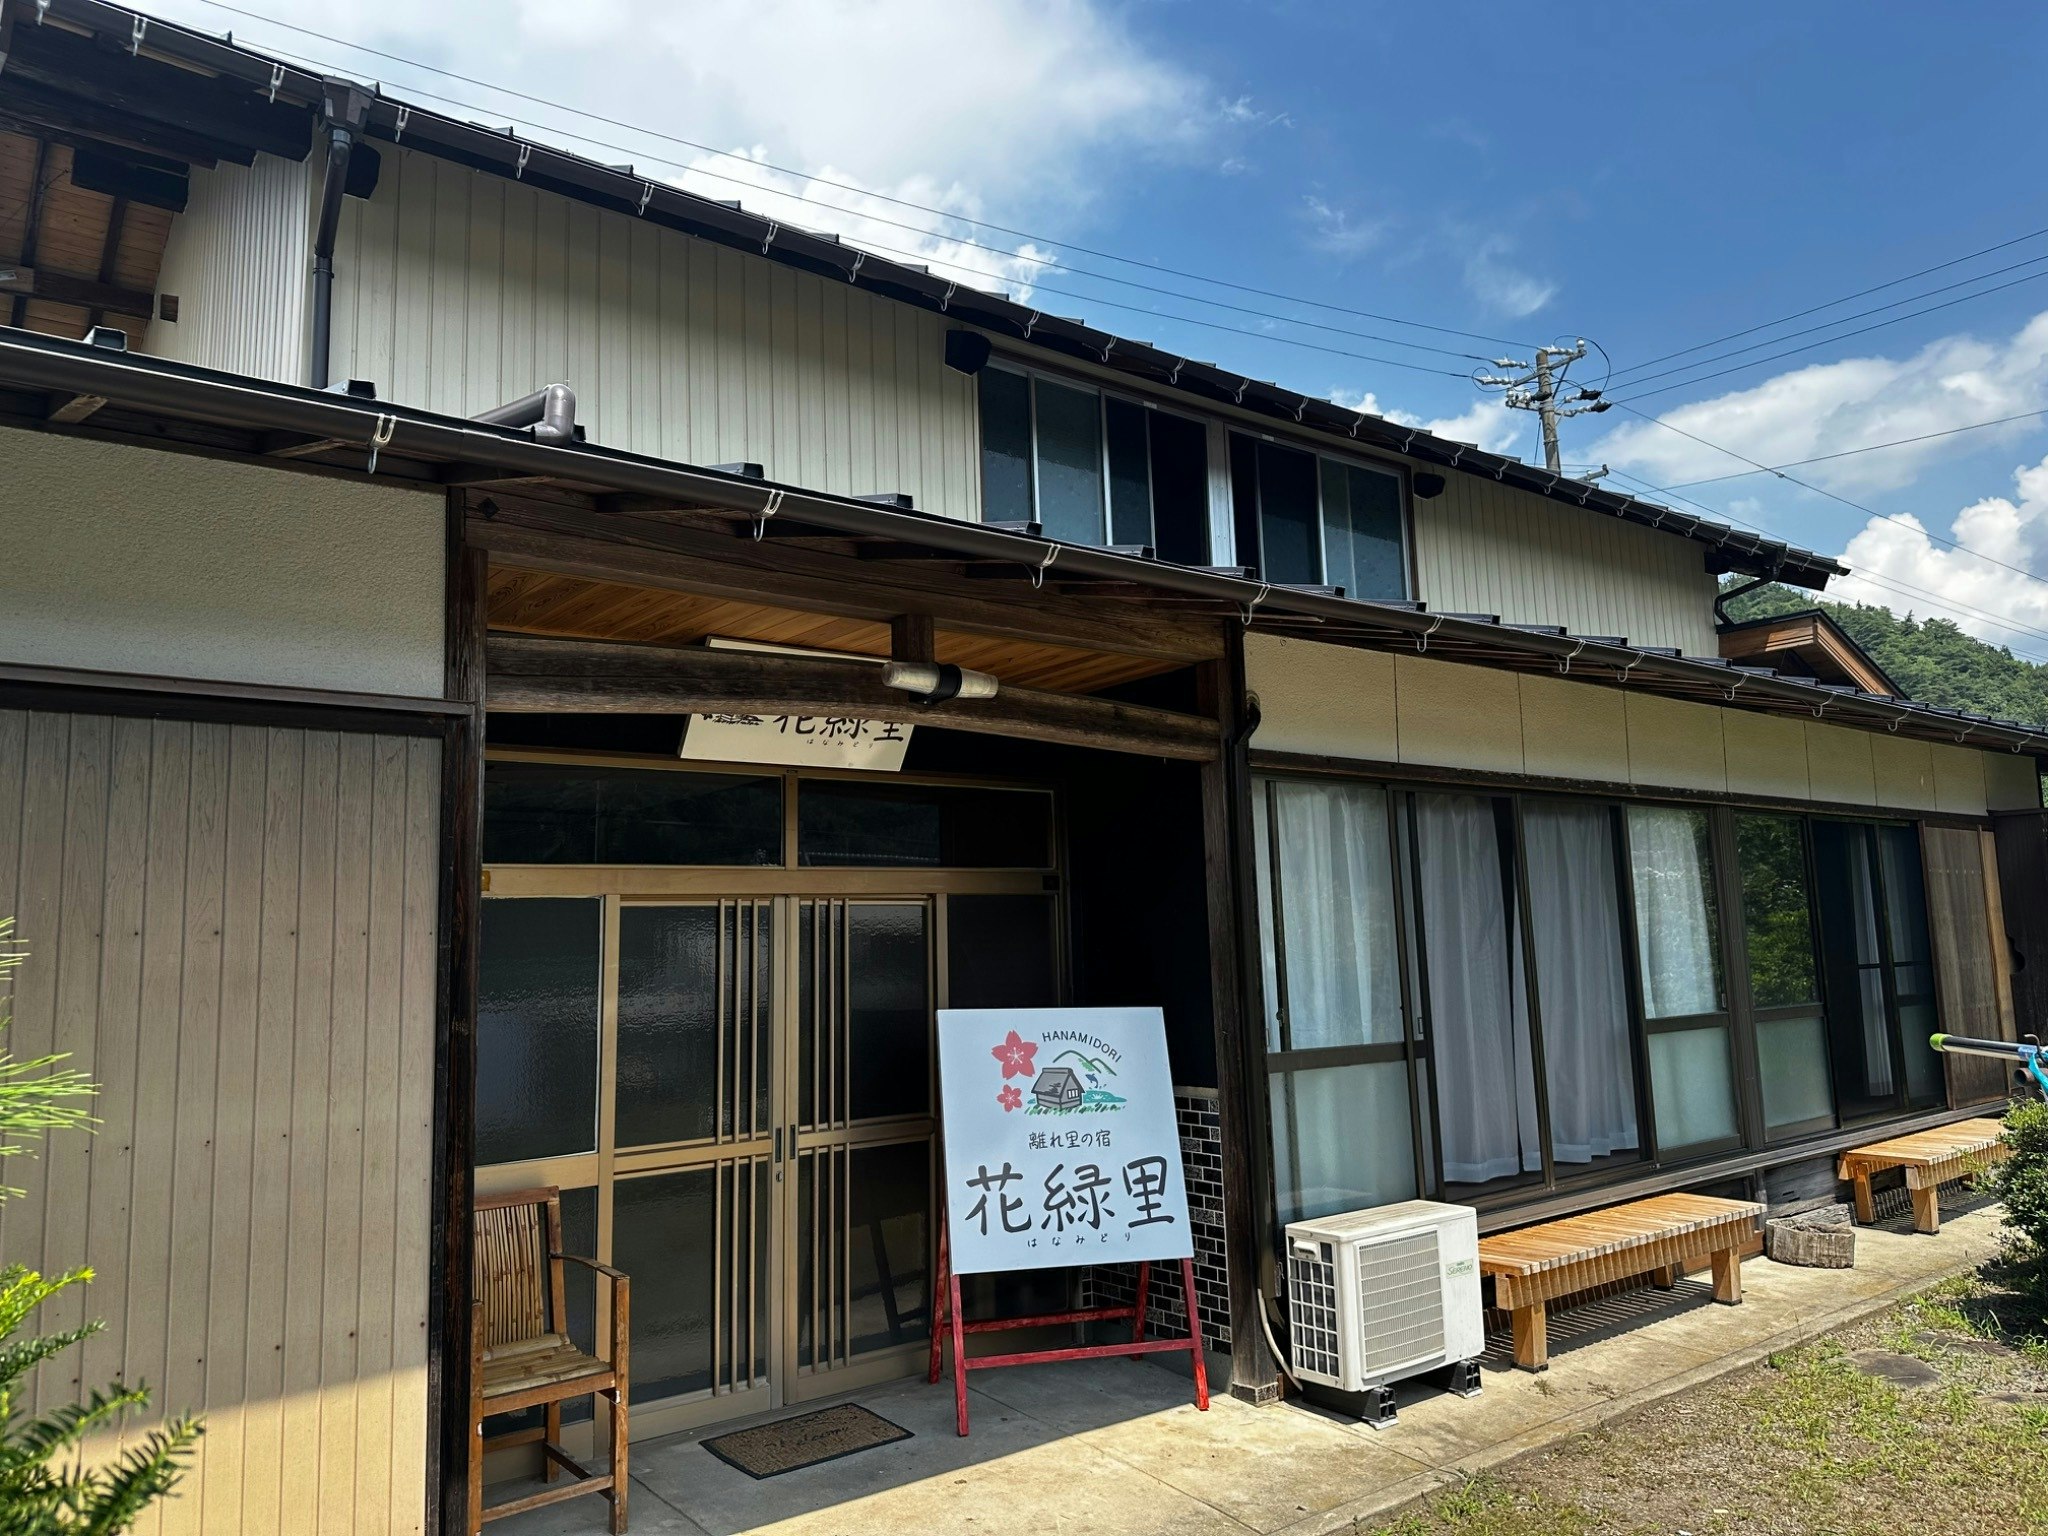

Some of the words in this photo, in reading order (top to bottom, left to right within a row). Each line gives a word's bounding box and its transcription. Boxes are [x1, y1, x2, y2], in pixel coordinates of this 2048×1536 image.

[1042, 1030, 1122, 1063] HANAMIDORI
[1028, 1130, 1111, 1150] 離れ里の宿
[965, 1156, 1175, 1235] 花緑里
[1027, 1232, 1132, 1248] はなみどり
